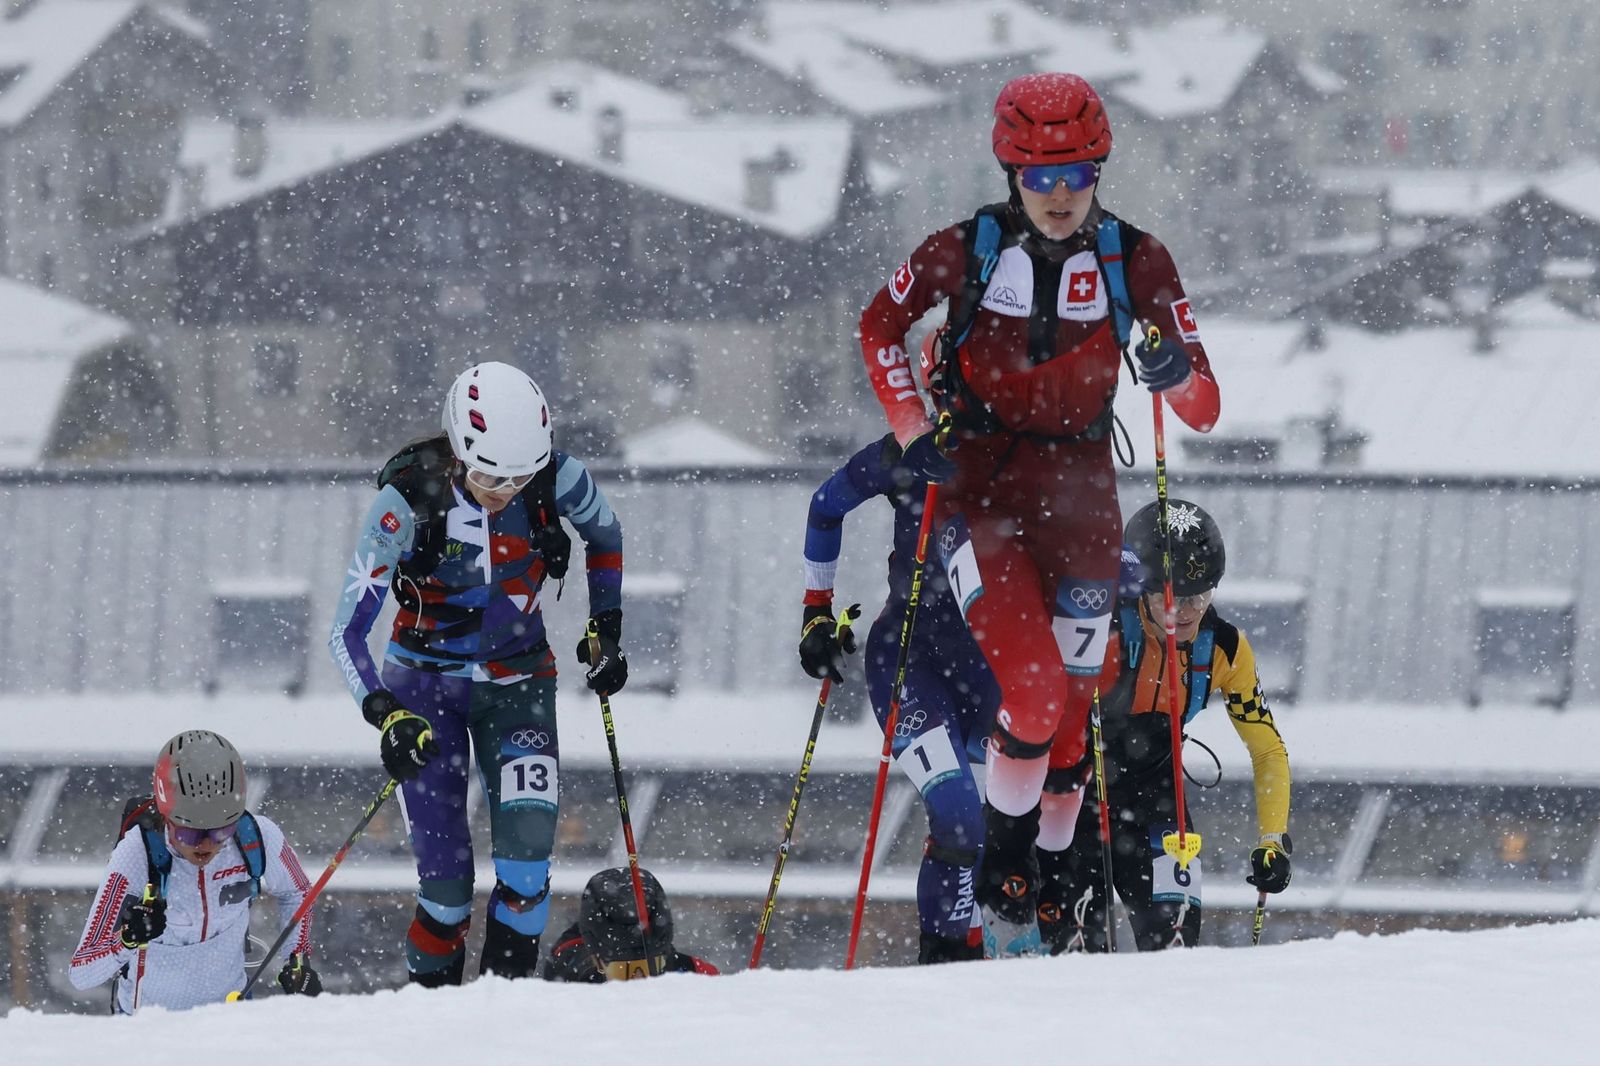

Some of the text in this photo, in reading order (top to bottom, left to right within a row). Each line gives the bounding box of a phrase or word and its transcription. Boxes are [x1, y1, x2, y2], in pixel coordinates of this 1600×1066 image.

[877, 344, 916, 401] SUI
[1157, 466, 1166, 498] LEKI
[909, 569, 923, 607] LEKI
[1074, 626, 1096, 658] 7
[601, 702, 614, 736] LEKI
[800, 740, 815, 783] LEKI
[913, 745, 932, 773] 1
[513, 763, 549, 792] 13
[1173, 860, 1191, 887] 6
[1253, 907, 1264, 933] LEKI
